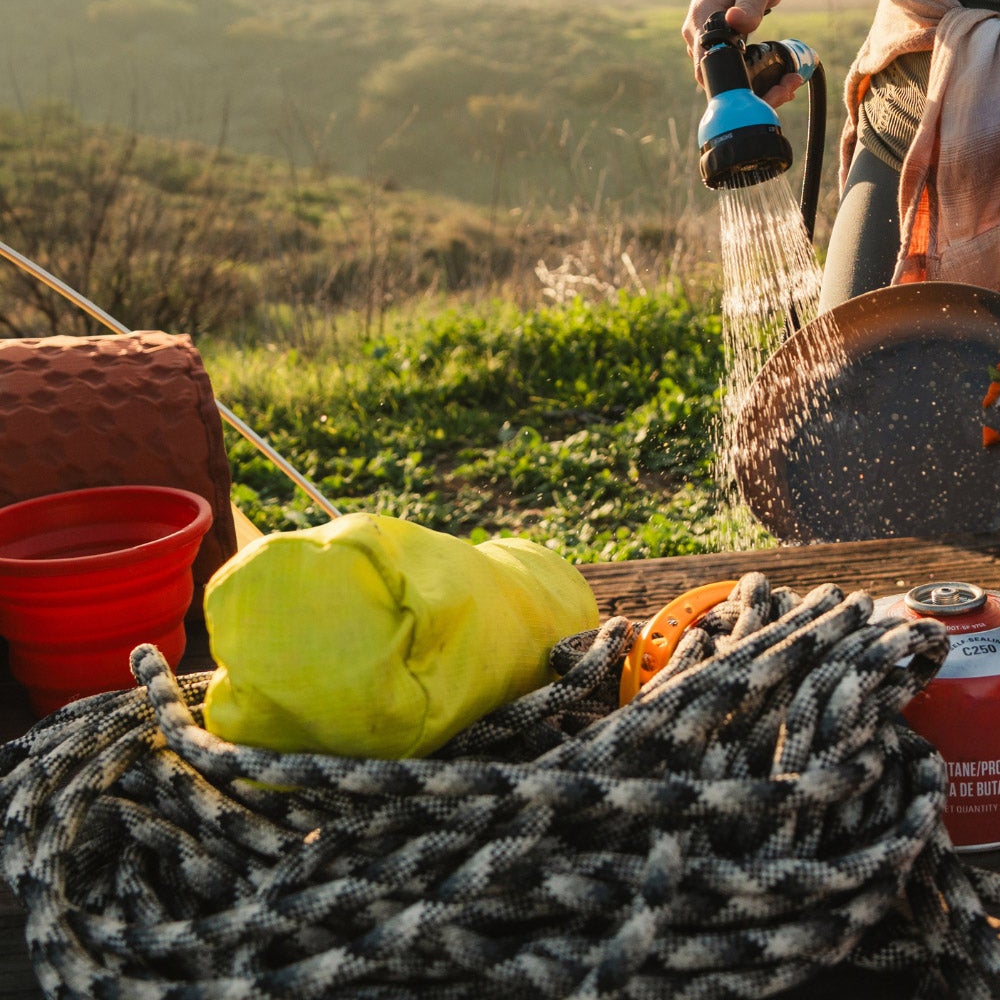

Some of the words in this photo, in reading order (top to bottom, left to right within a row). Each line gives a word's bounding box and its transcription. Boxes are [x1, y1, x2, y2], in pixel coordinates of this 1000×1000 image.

[962, 644, 997, 656] C250
[960, 782, 974, 797] DE
[956, 803, 998, 813] QUANTITY
